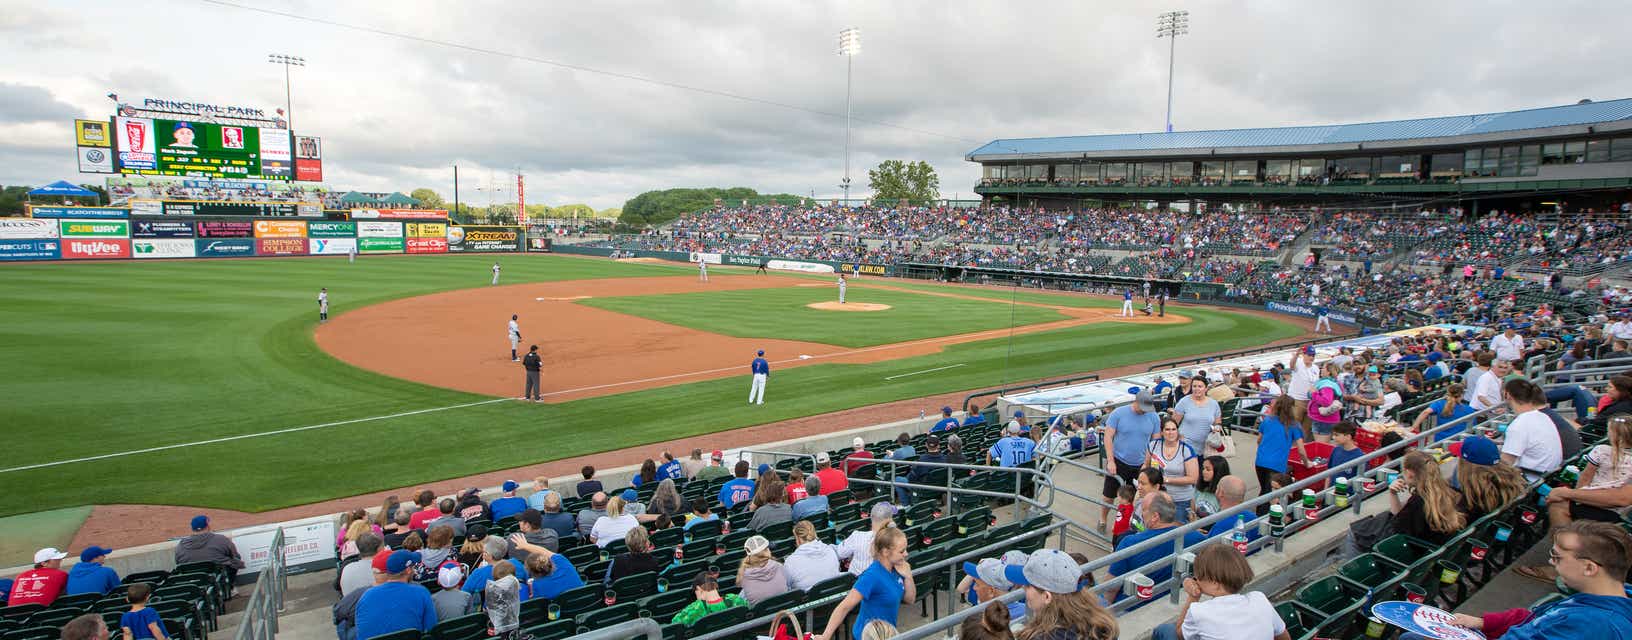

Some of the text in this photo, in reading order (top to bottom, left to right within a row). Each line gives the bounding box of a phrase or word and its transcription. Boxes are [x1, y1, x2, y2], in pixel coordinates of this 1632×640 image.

[144, 98, 264, 117] PRINCIPAL PARK
[68, 224, 121, 233] SUBWAY
[309, 223, 353, 231] MERCYONE
[465, 231, 517, 240] XTREAM
[1274, 303, 1297, 313] Principal
[1012, 451, 1026, 465] 10
